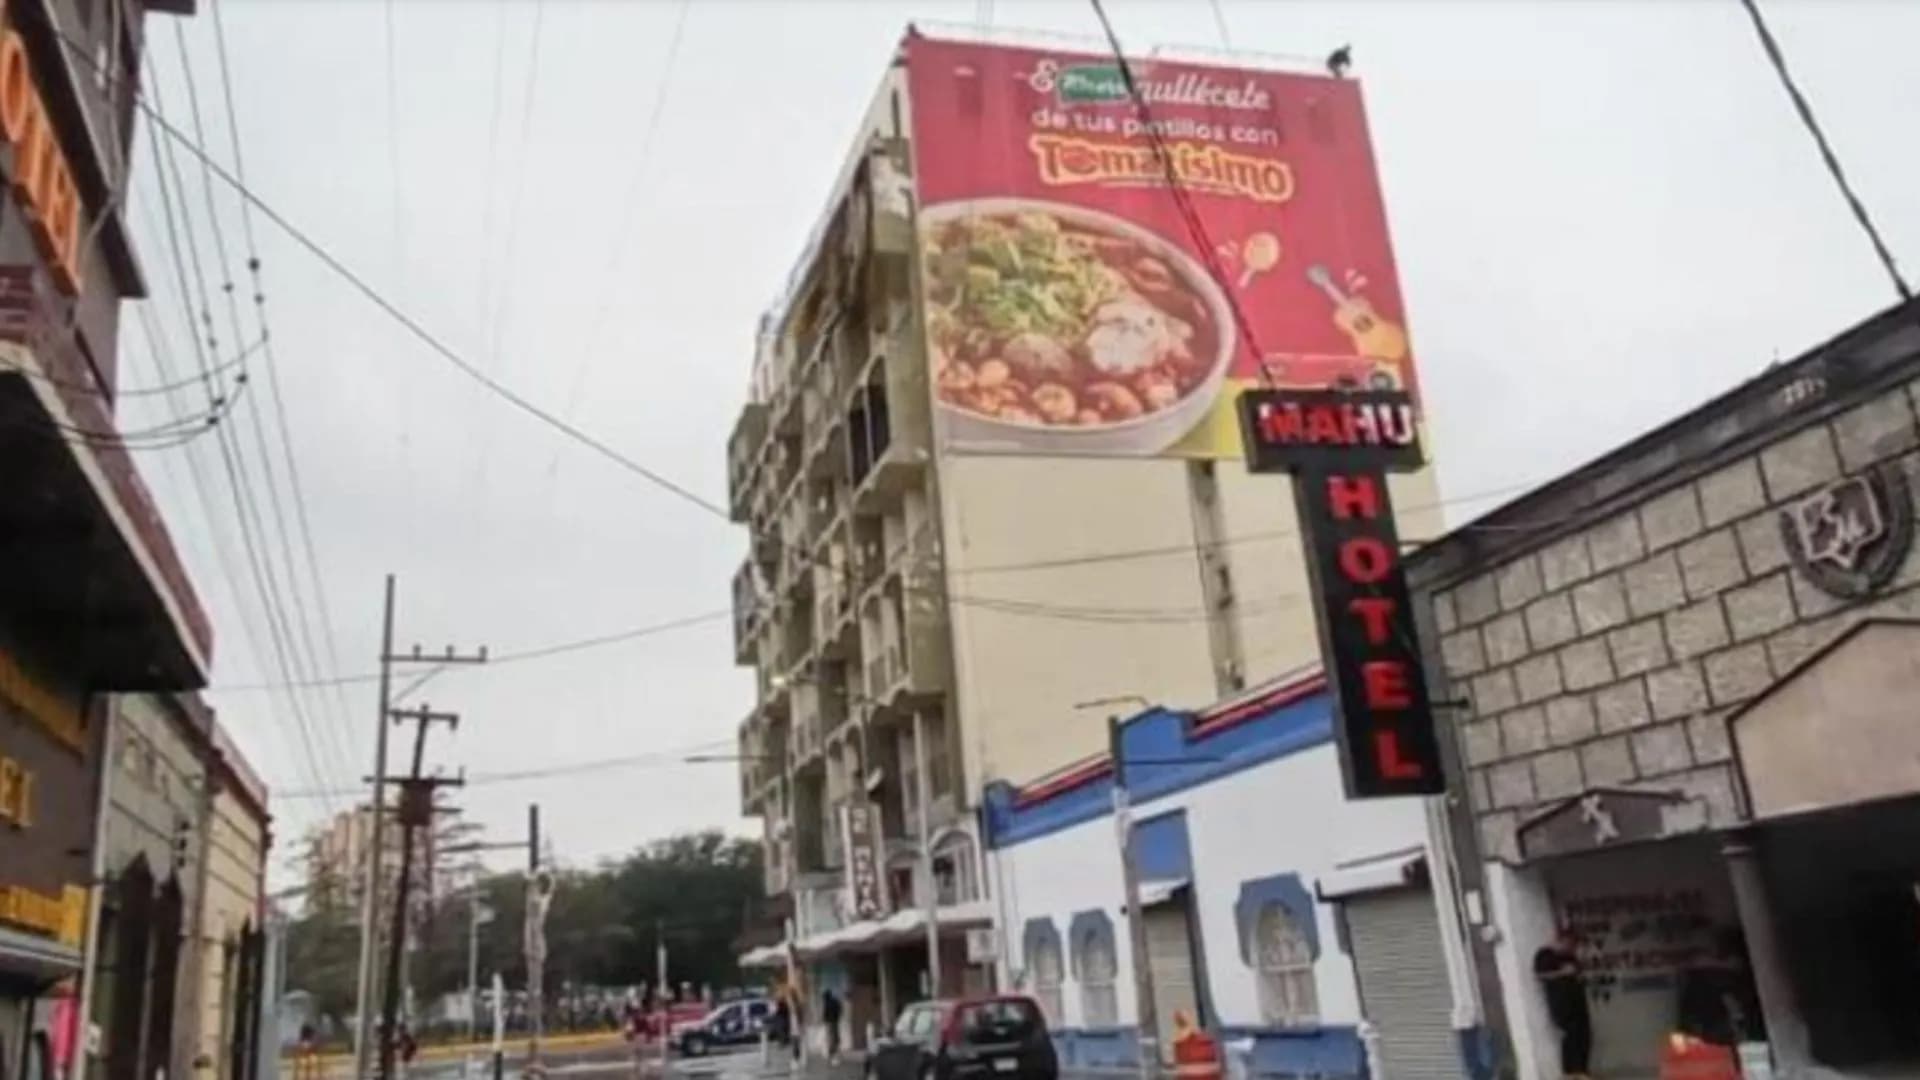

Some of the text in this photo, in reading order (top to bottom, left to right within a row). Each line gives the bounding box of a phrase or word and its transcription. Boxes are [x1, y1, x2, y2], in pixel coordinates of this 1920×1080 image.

[1032, 107, 1068, 129] de
[1074, 111, 1116, 133] tus
[1230, 125, 1279, 148] con
[1257, 401, 1415, 445] MAHU
[1326, 475, 1422, 781] HOTEL
